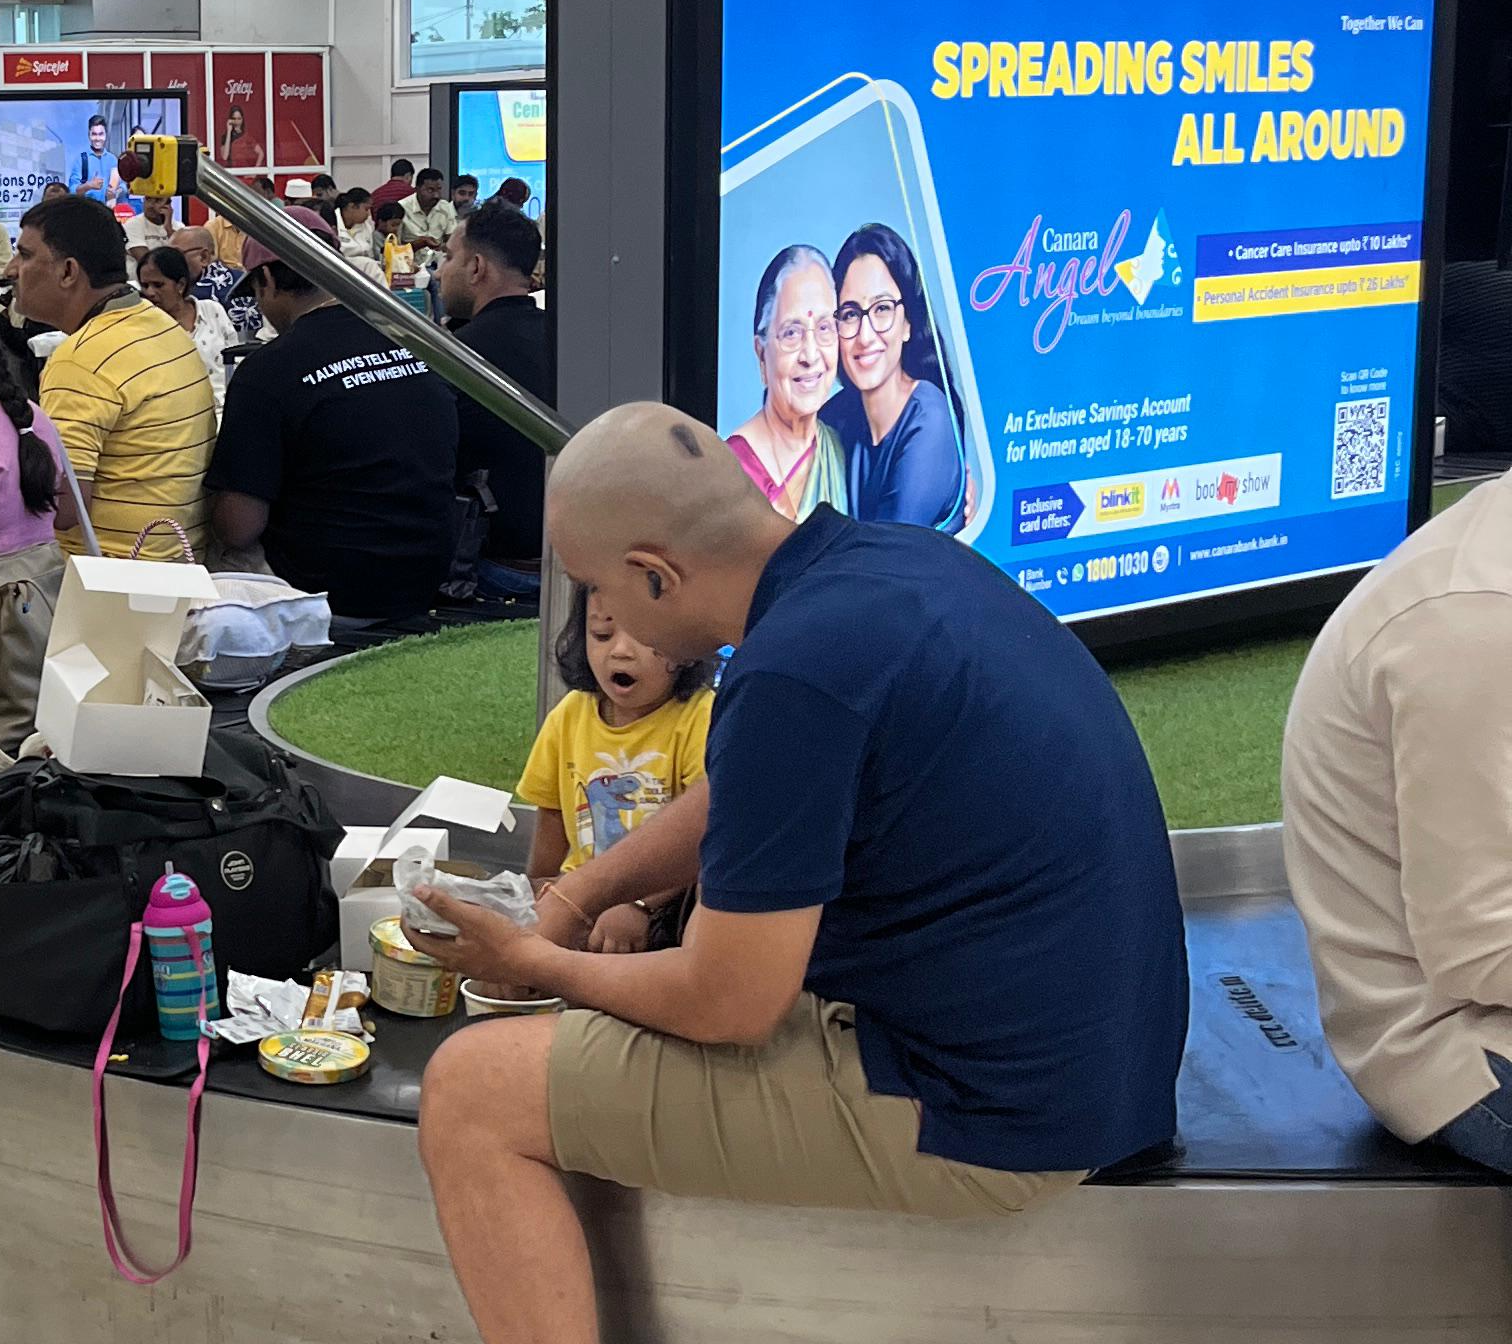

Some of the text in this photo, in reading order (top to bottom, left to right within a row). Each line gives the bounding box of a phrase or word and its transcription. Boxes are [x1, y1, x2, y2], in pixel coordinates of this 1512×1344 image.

[1341, 15, 1424, 34] Together We Can
[931, 40, 1315, 99] SPREADING SMILES
[1172, 107, 1405, 166] ALL AROUND
[27, 173, 61, 190] Open
[1042, 228, 1099, 253] Canara
[1236, 244, 1269, 261] Cancer
[1270, 242, 1293, 258] Care
[1294, 239, 1338, 256] Insurance
[1340, 237, 1361, 255] upto
[970, 209, 1131, 354] Angel
[1203, 288, 1245, 306] Personal
[1248, 285, 1289, 302] Accident
[1291, 282, 1334, 299] Insurance
[1337, 280, 1358, 297] upto
[1068, 311, 1099, 327] Dream
[1101, 306, 1134, 327] beyond
[316, 356, 365, 383] ALWAYS
[363, 352, 393, 367] TELL
[388, 347, 414, 362] THE
[342, 370, 377, 389] EVEN
[374, 364, 407, 382] WHEN
[409, 360, 429, 375] LIE
[1004, 394, 1191, 434] An Exclusive Savings Account
[1006, 425, 1188, 463] for Women aged 18-70 years
[1242, 471, 1271, 494] show
[1020, 496, 1063, 516] Exclusive
[1100, 488, 1141, 510] blinkit
[1160, 501, 1181, 513] Myntra
[1019, 513, 1072, 533] card offers:
[1086, 550, 1149, 582] 1800 1030
